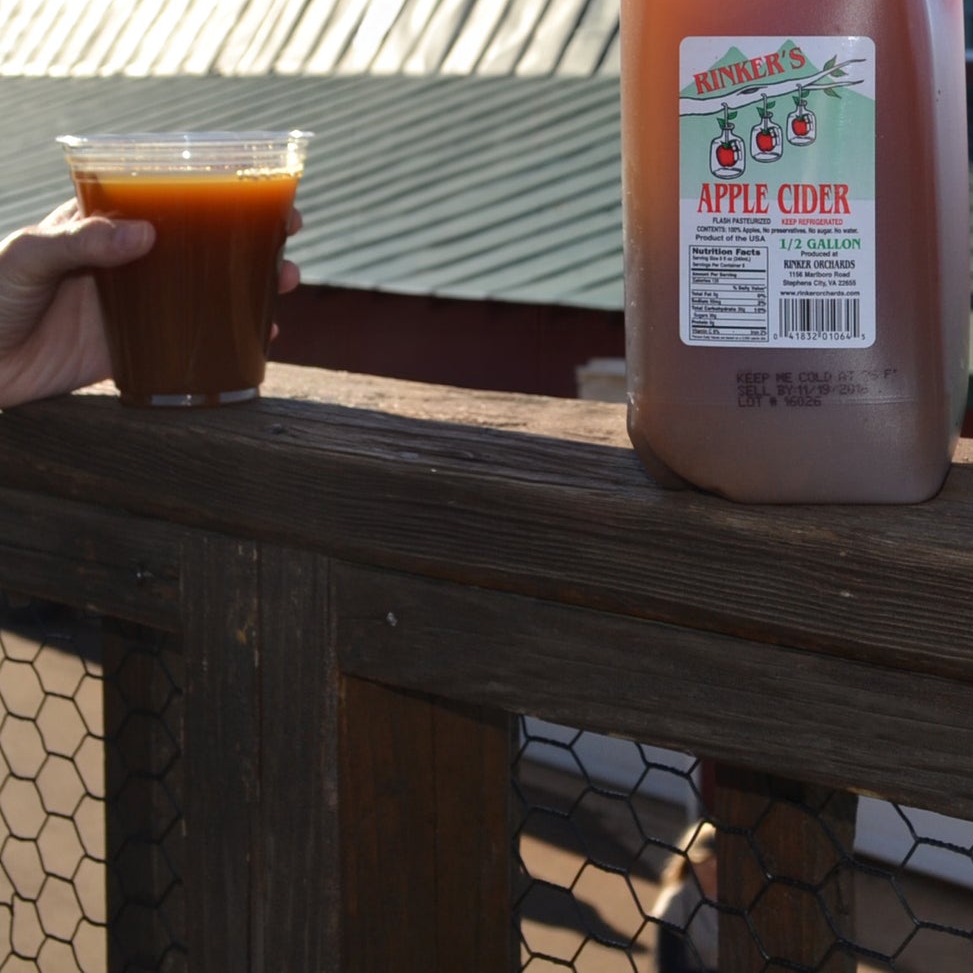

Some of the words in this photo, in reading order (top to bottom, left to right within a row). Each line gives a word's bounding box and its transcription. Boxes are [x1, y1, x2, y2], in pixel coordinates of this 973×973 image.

[693, 47, 807, 95] RINKER'S
[697, 183, 769, 214] APPLE
[777, 183, 851, 214] CIDER
[712, 217, 731, 225] FLASH
[732, 217, 772, 225] PASTEURIZED
[781, 218, 797, 226] KEEP
[798, 218, 843, 226] REFRIGERATED
[749, 234, 766, 242] USA
[779, 238, 802, 251] 1/2
[807, 238, 861, 250] GALLON
[735, 248, 761, 256] Facts
[783, 260, 812, 269] RINKER
[813, 260, 856, 269] ORCHARDS
[783, 279, 812, 287] Stephens
[736, 371, 769, 384] KEEP
[798, 371, 832, 384] COLD
[737, 396, 763, 408] LOT
